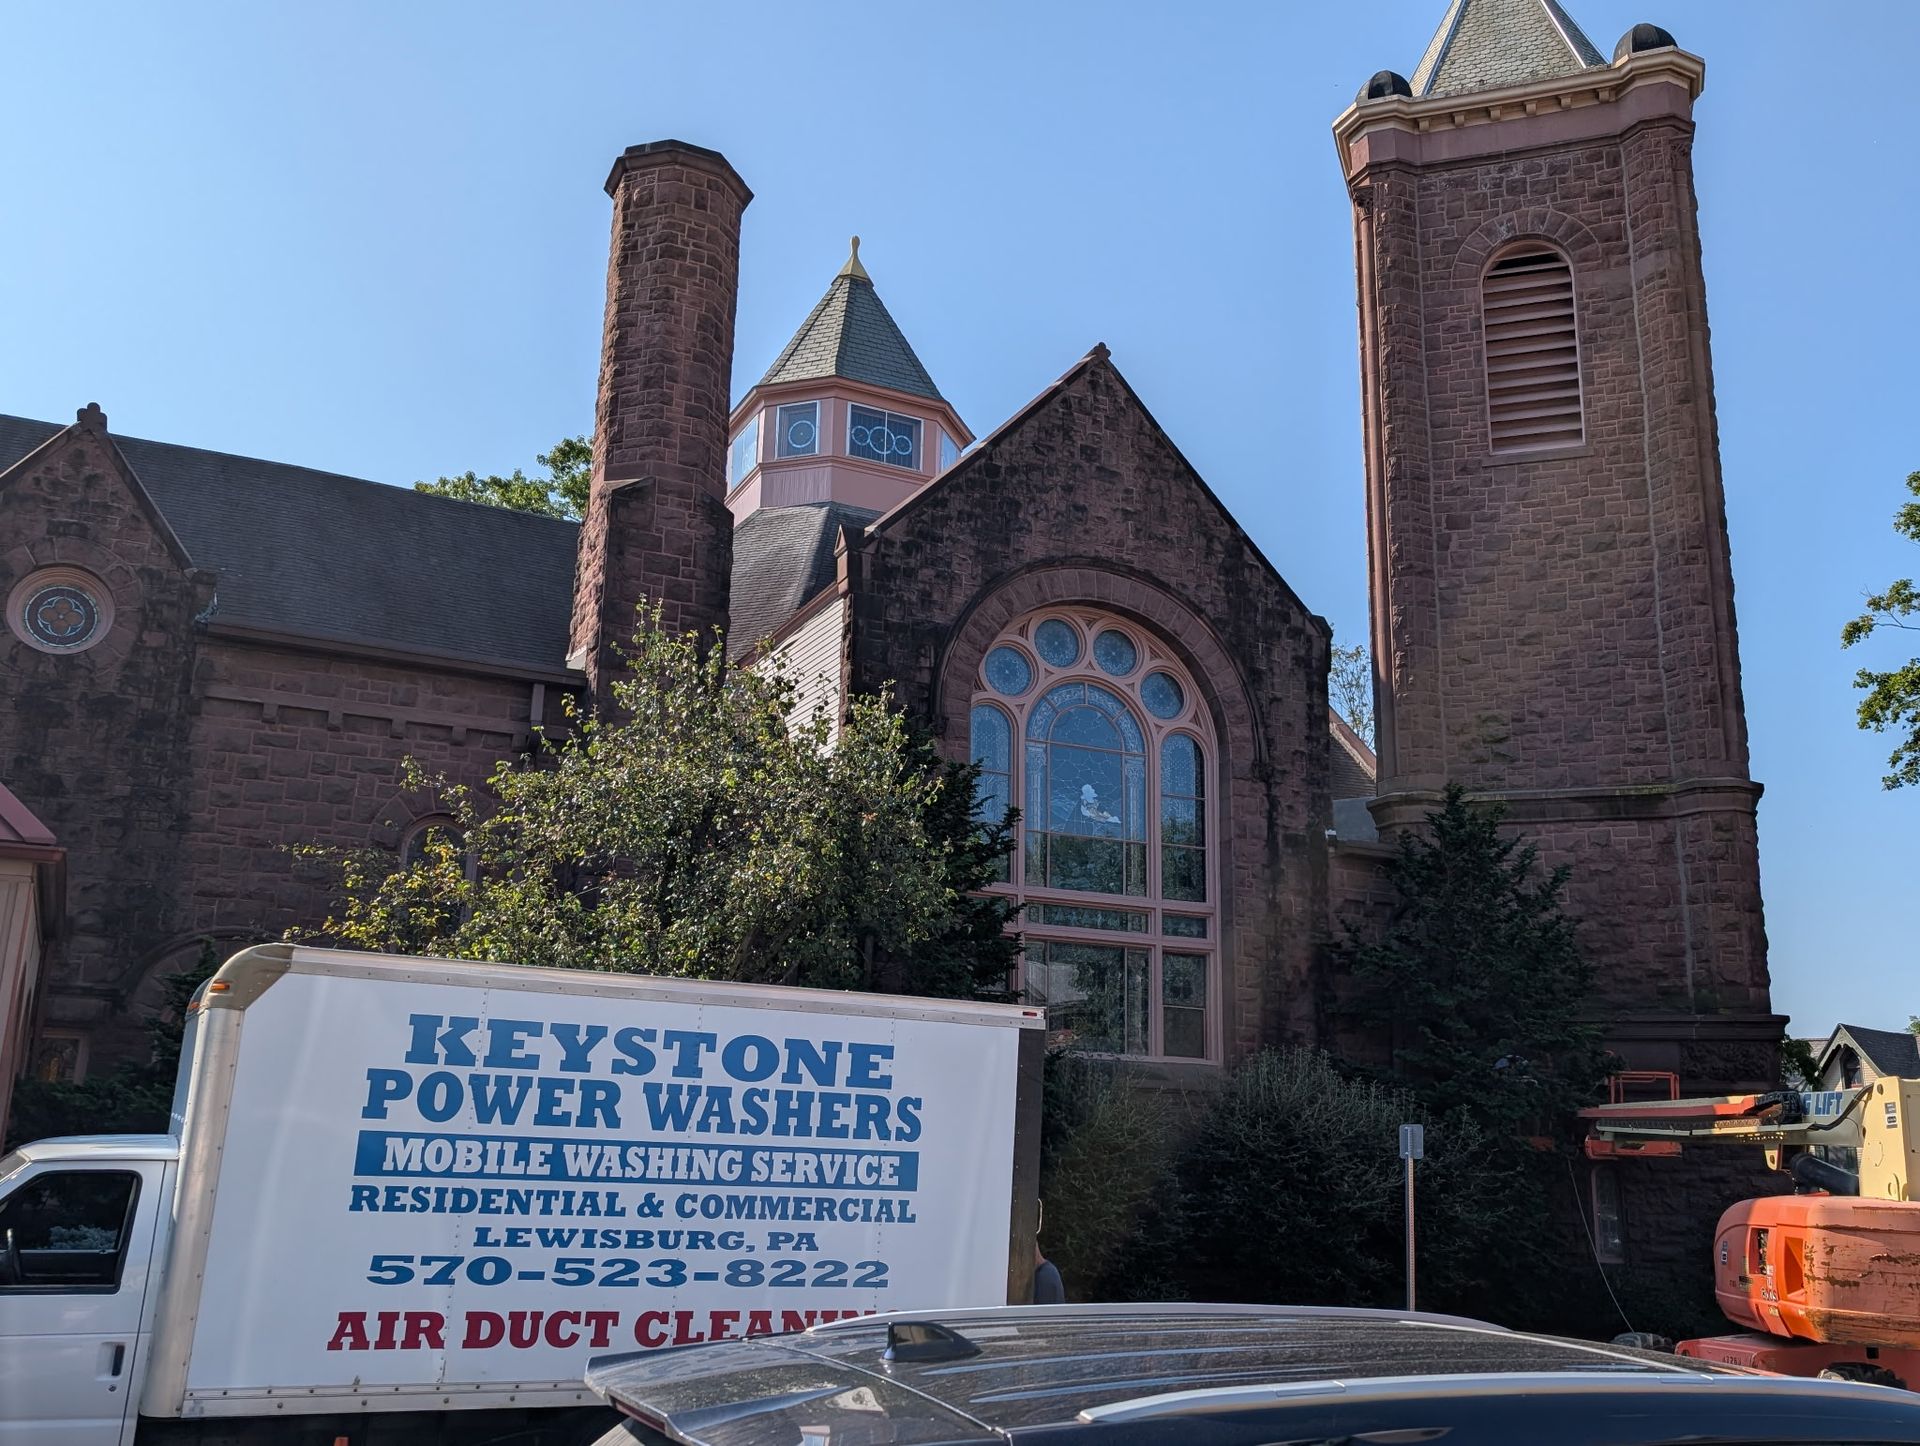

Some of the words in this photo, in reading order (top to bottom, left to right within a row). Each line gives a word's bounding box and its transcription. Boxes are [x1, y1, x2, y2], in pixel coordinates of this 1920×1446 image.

[404, 1013, 896, 1090] KEYSTONE
[361, 1068, 622, 1130] POWER
[642, 1082, 923, 1143] WASHERS
[1814, 1091, 1843, 1116] LIFT
[382, 1137, 553, 1175] MOBILE
[562, 1144, 743, 1181] WASHING
[750, 1151, 900, 1186] SERVICE
[348, 1184, 627, 1218] RESIDENTIAL
[636, 1192, 664, 1218] &
[674, 1193, 917, 1224] COMMERCIAL
[473, 1226, 756, 1253] LEWISBURG,
[766, 1231, 820, 1252] PA
[366, 1254, 890, 1289] 570-523-8222
[327, 1311, 445, 1351] AIR
[462, 1310, 620, 1349] DUCT
